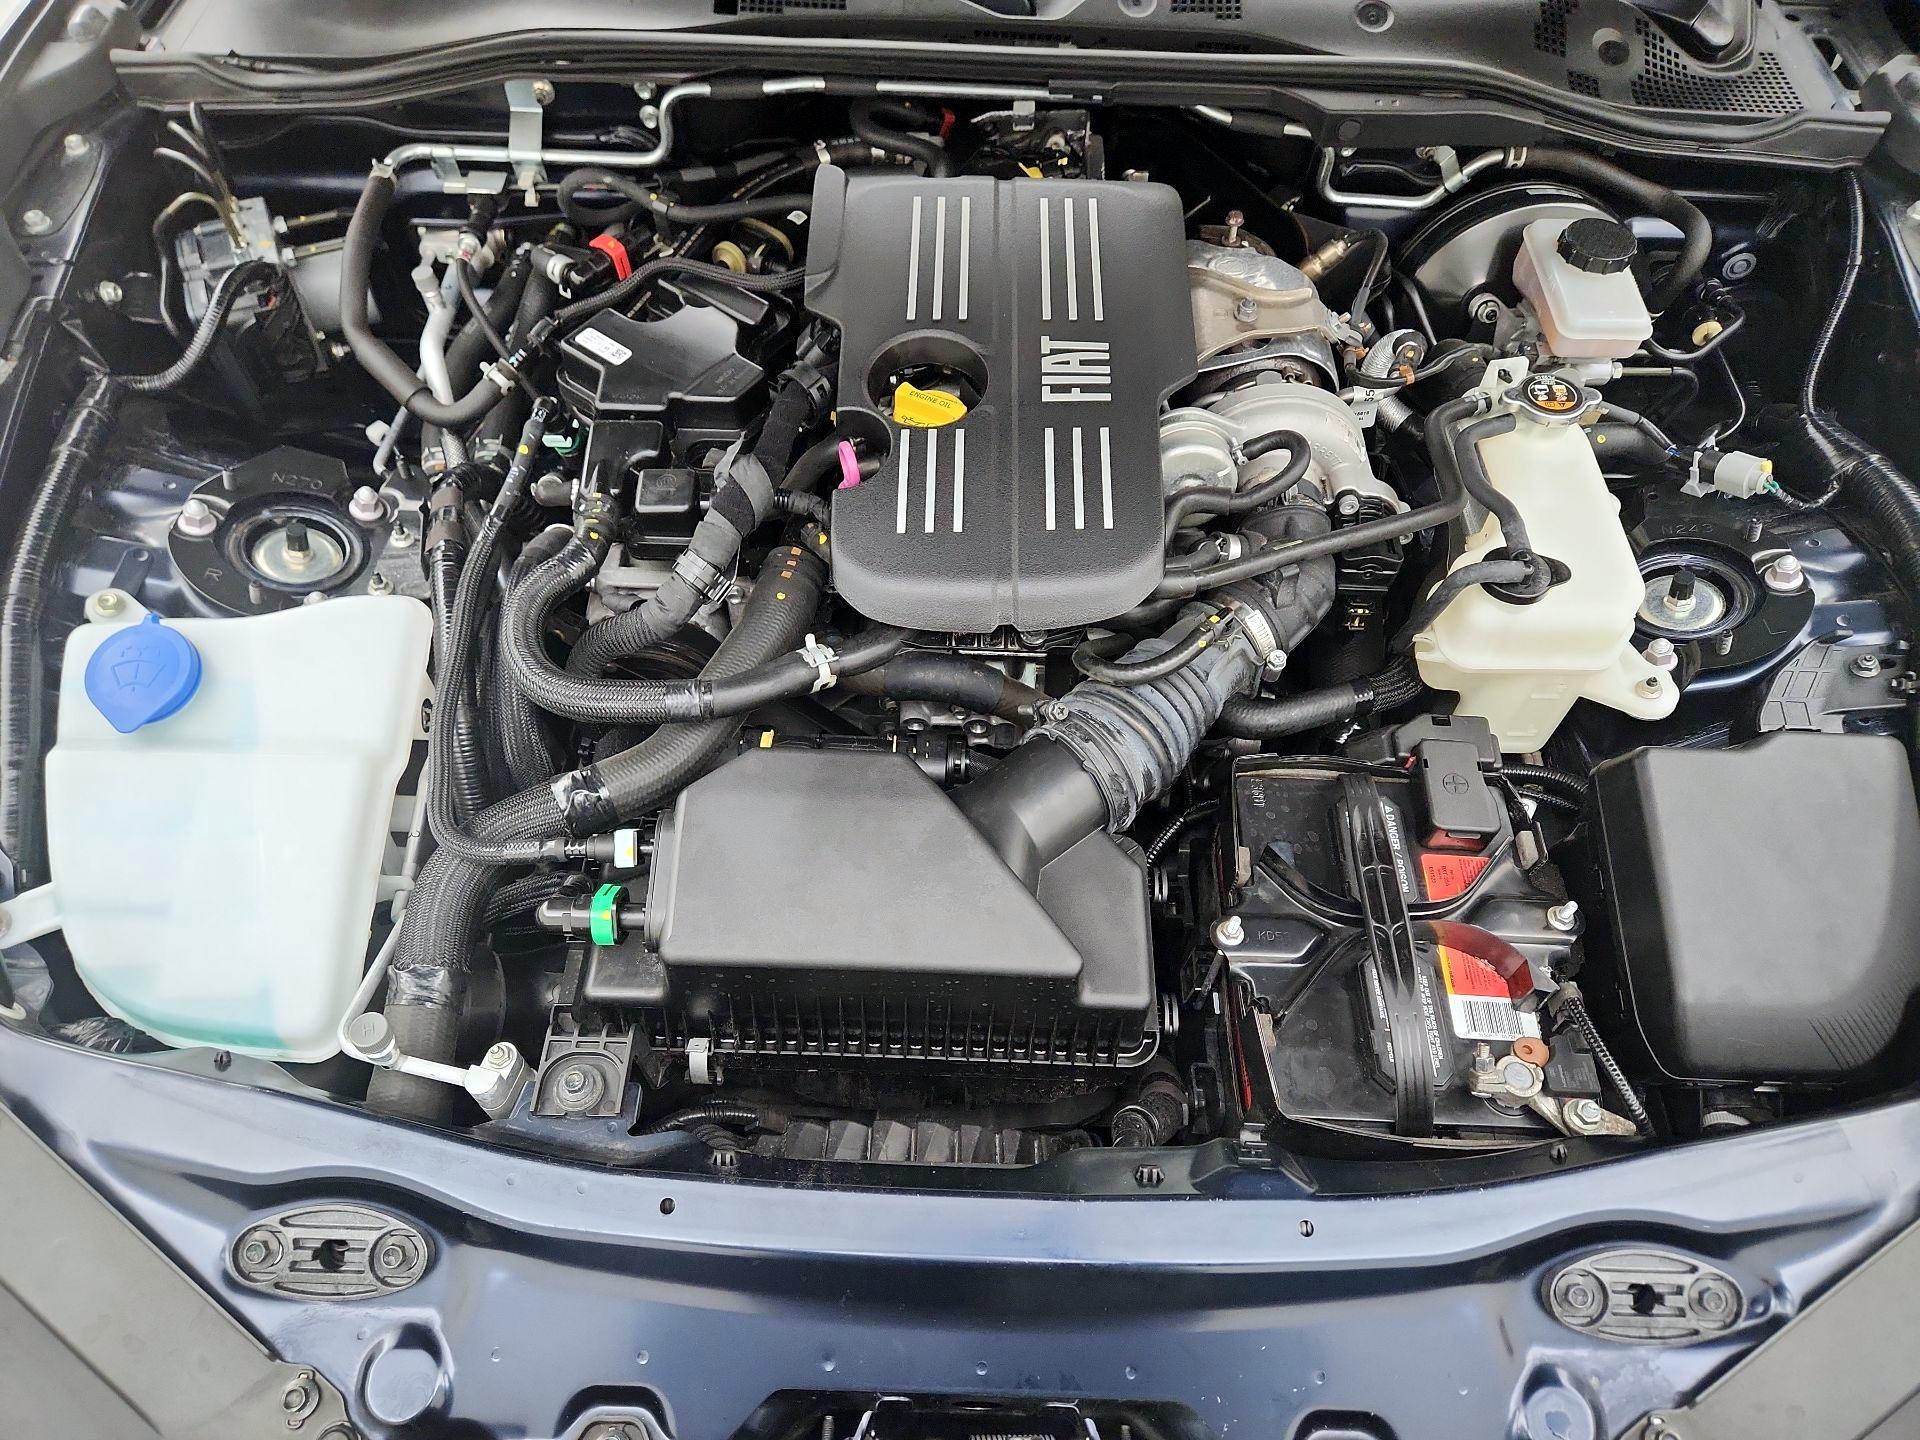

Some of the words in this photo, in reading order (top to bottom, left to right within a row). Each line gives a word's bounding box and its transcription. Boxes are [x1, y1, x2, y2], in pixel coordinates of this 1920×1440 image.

[1041, 336, 1111, 401] FIAT
[909, 391, 937, 404] ENGINE
[939, 400, 951, 409] OIL
[272, 472, 322, 489] N270
[205, 567, 223, 581] R
[1386, 814, 1401, 850] DANGER
[1396, 859, 1409, 893] POISON
